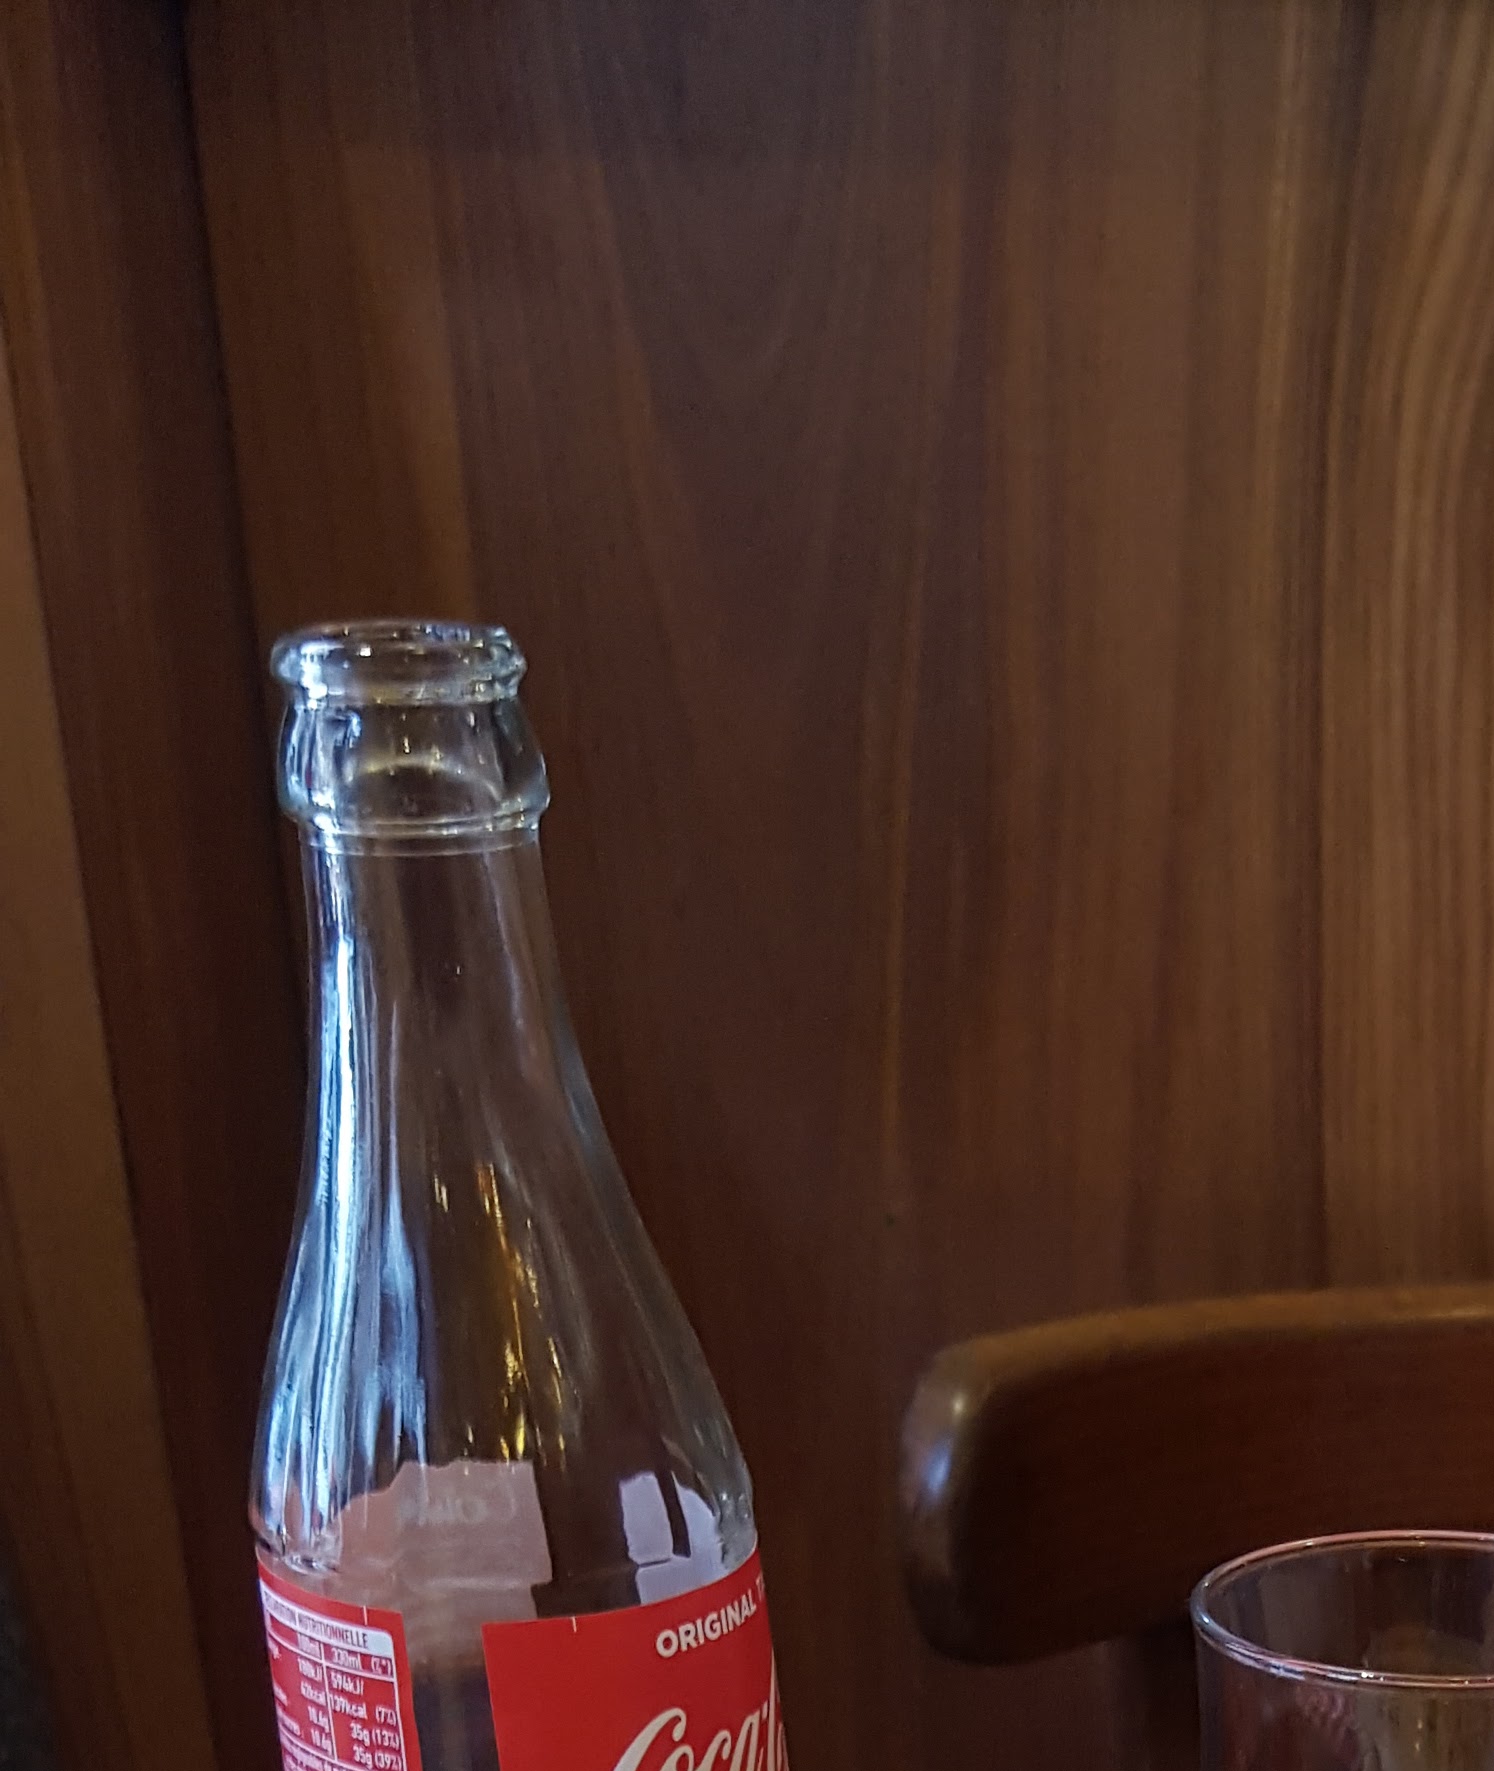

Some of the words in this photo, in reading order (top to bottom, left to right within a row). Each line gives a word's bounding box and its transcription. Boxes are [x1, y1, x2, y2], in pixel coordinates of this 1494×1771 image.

[655, 1588, 757, 1659] ORIGINAL
[349, 1721, 370, 1748] 35g
[352, 1743, 373, 1770] 35g
